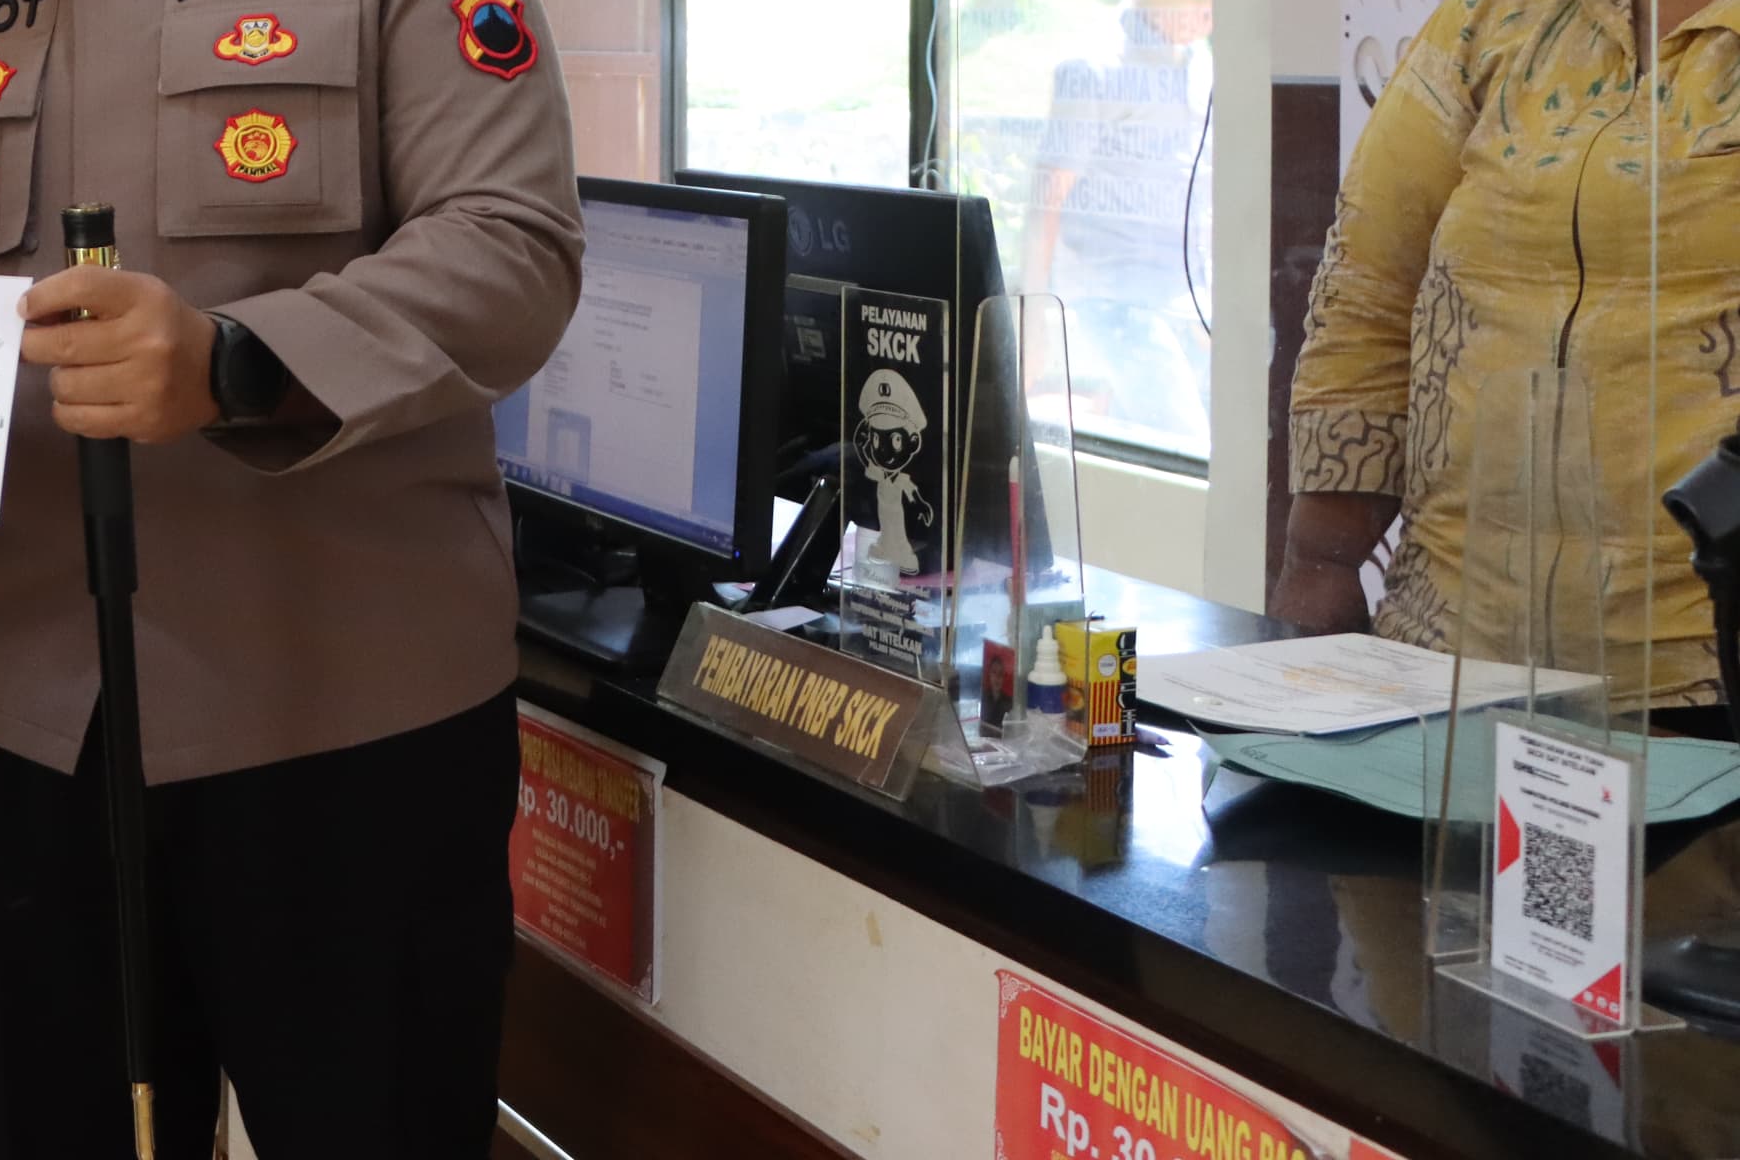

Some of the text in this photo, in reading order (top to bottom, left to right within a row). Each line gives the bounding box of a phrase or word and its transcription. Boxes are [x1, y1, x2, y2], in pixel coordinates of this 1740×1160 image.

[818, 217, 851, 252] LG
[861, 305, 927, 332] PELAYANAN
[867, 327, 921, 364] SKCK
[692, 635, 900, 759] PEMBAYARAN PNBP SKCK
[1019, 1006, 1083, 1087] BAYAR
[1089, 1042, 1179, 1139] DENGAN
[1185, 1092, 1251, 1160] UANG
[1040, 1082, 1098, 1158] Rp.
